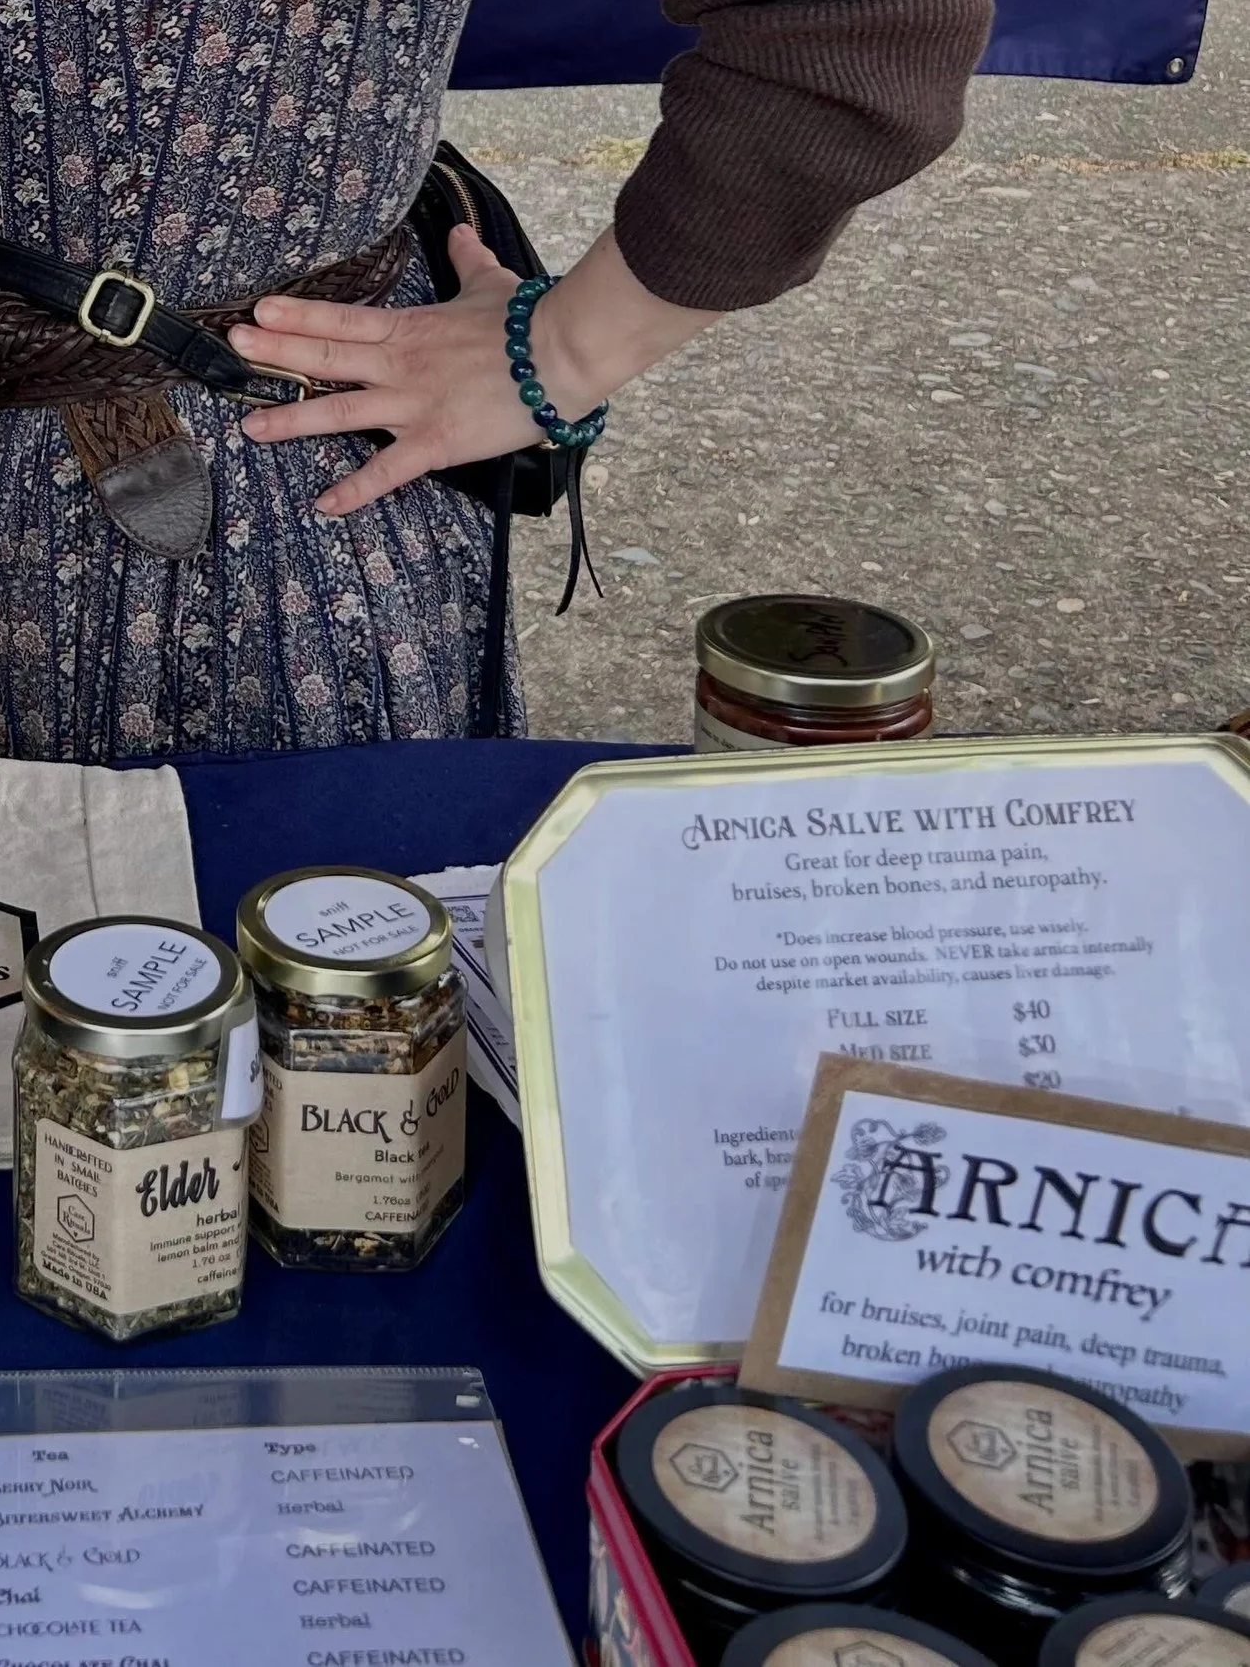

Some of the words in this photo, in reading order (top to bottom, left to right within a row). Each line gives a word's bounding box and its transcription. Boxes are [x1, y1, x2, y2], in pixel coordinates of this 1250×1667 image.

[784, 852, 838, 872] Great
[844, 851, 871, 869] for
[875, 849, 923, 871] deep
[927, 847, 997, 864] trauma
[1001, 843, 1048, 864] pain,
[732, 881, 808, 903] bruises,
[812, 879, 879, 899] broken
[885, 875, 947, 896] bones,
[950, 872, 988, 892] and
[992, 868, 1108, 894] neuropathy.
[296, 902, 415, 948] SAMPLE
[892, 924, 934, 941] blood
[333, 943, 361, 957] NOT
[362, 935, 389, 948] FOR
[391, 924, 419, 938] SALE
[934, 944, 994, 961] NEVER
[111, 940, 187, 1012] SAMPLE
[756, 975, 811, 994] despite
[815, 972, 868, 988] market
[1013, 999, 1051, 1023] $40
[1019, 1034, 1056, 1057] $30
[301, 1104, 393, 1144] BLACK
[426, 1066, 459, 1118] GOLD
[54, 1153, 65, 1166] IN
[375, 1149, 415, 1163] Black
[135, 1157, 220, 1217] Elder
[335, 1171, 394, 1184] Bergamot
[196, 1203, 240, 1227] herbal
[194, 1225, 235, 1244] support
[158, 1248, 190, 1263] lemon
[193, 1242, 219, 1255] balm
[916, 1245, 1002, 1278] with
[1011, 1259, 1173, 1322] comfrey
[819, 1291, 855, 1316] for
[861, 1302, 947, 1333] bruises,
[950, 1309, 1010, 1341] joint
[1015, 1324, 1072, 1353] pain,
[1080, 1335, 1137, 1368] deep
[1144, 1347, 1227, 1379] trauma,
[841, 1336, 922, 1368] broken
[32, 1450, 69, 1462] Tea
[264, 1442, 316, 1455] Type
[1018, 1407, 1055, 1514] Arnica
[271, 1466, 414, 1483] CAFFEINATED
[739, 1430, 774, 1536] Arnica
[277, 1500, 345, 1515] Herbal
[286, 1541, 435, 1558] CAFFEINATED
[293, 1577, 445, 1596] CAFFEINATED
[110, 1619, 142, 1634] TEA
[300, 1613, 371, 1629] Herbal
[307, 1648, 465, 1667] CAFFEINATED
